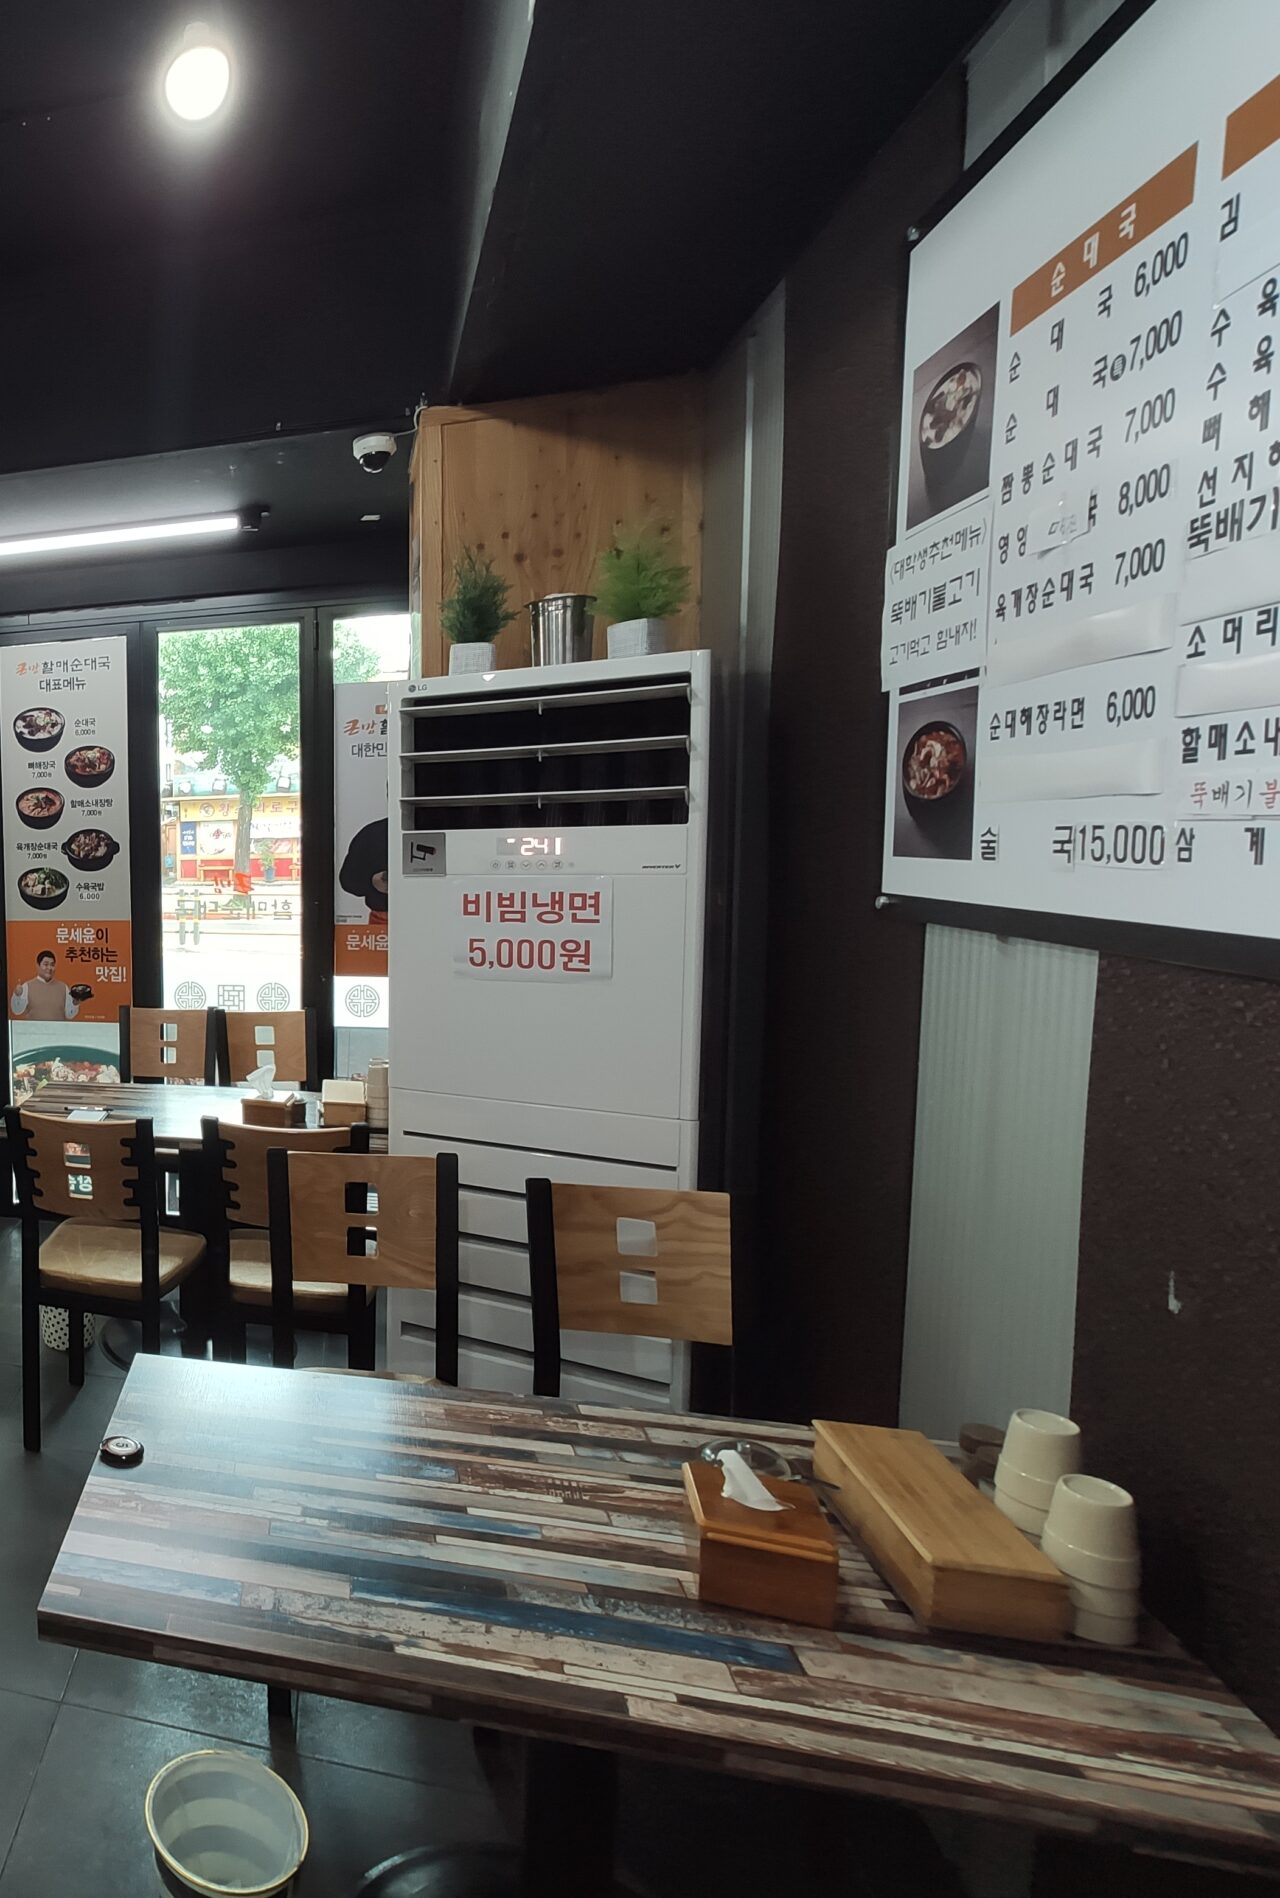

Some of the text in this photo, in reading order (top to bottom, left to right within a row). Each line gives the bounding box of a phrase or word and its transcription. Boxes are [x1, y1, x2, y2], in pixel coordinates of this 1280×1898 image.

[1133, 232, 1189, 298] 6,000
[1129, 310, 1183, 372] 7,000
[1000, 387, 1176, 506] 짬뽕순대국 7,000
[1118, 462, 1171, 517] 8,000
[1186, 486, 1280, 553] 뚝배기
[890, 567, 981, 625] 뚝배기불고기
[995, 538, 1166, 623] 육개장순대국 7,000
[889, 617, 978, 666] 고기먹고 힘내자!
[39, 676, 87, 693] 대표메뉴
[41, 656, 111, 674] 할매순대국
[73, 717, 97, 728] 순대국
[1106, 684, 1157, 728] 6,000
[1078, 824, 1166, 867] 15,000
[462, 890, 601, 924] 비빔냉면
[55, 926, 109, 944] 문세윤이
[65, 947, 118, 963] 추천하는
[468, 938, 591, 974] 5,000원
[95, 966, 127, 983] 맛집!
